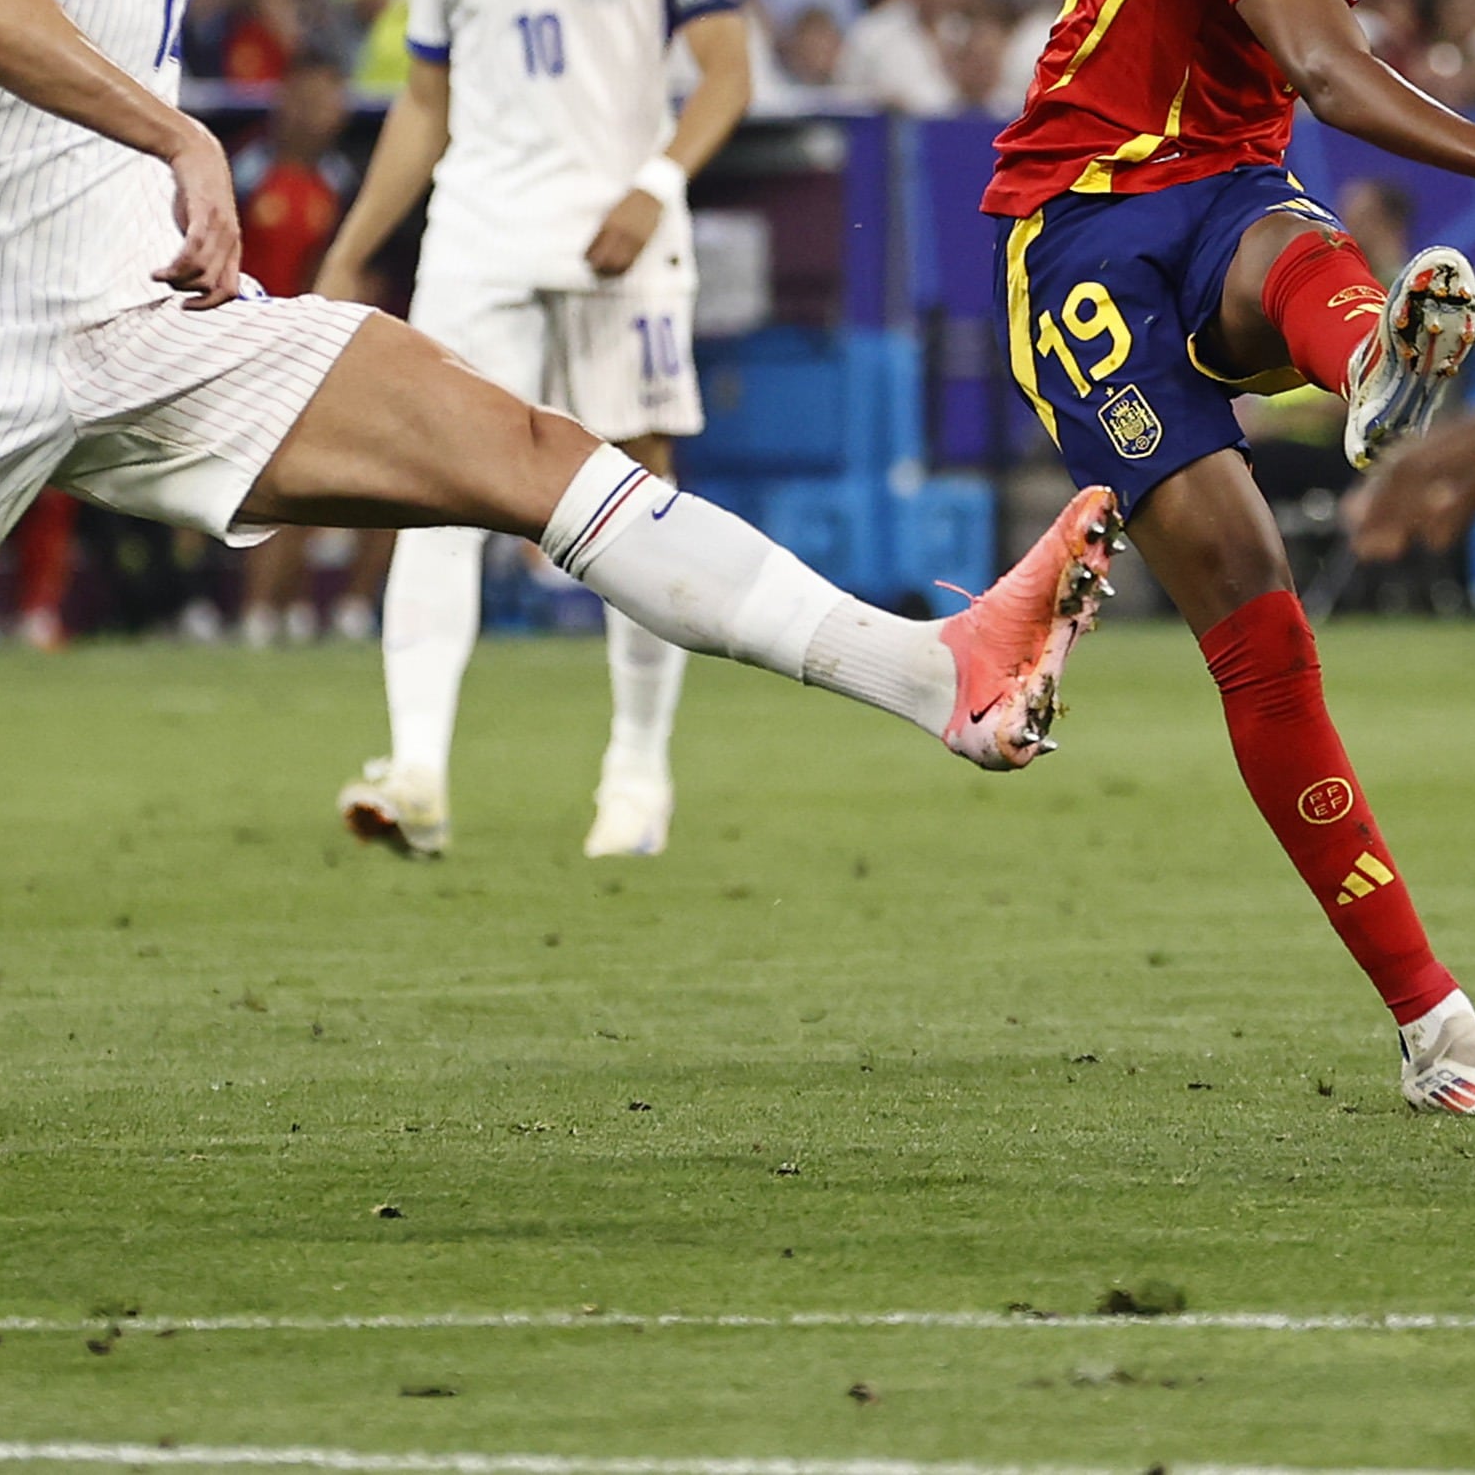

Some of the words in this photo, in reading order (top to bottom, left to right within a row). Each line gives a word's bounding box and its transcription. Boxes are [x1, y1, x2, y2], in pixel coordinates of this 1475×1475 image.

[515, 11, 566, 76] 10
[633, 314, 681, 381] 10
[1036, 281, 1133, 399] 19
